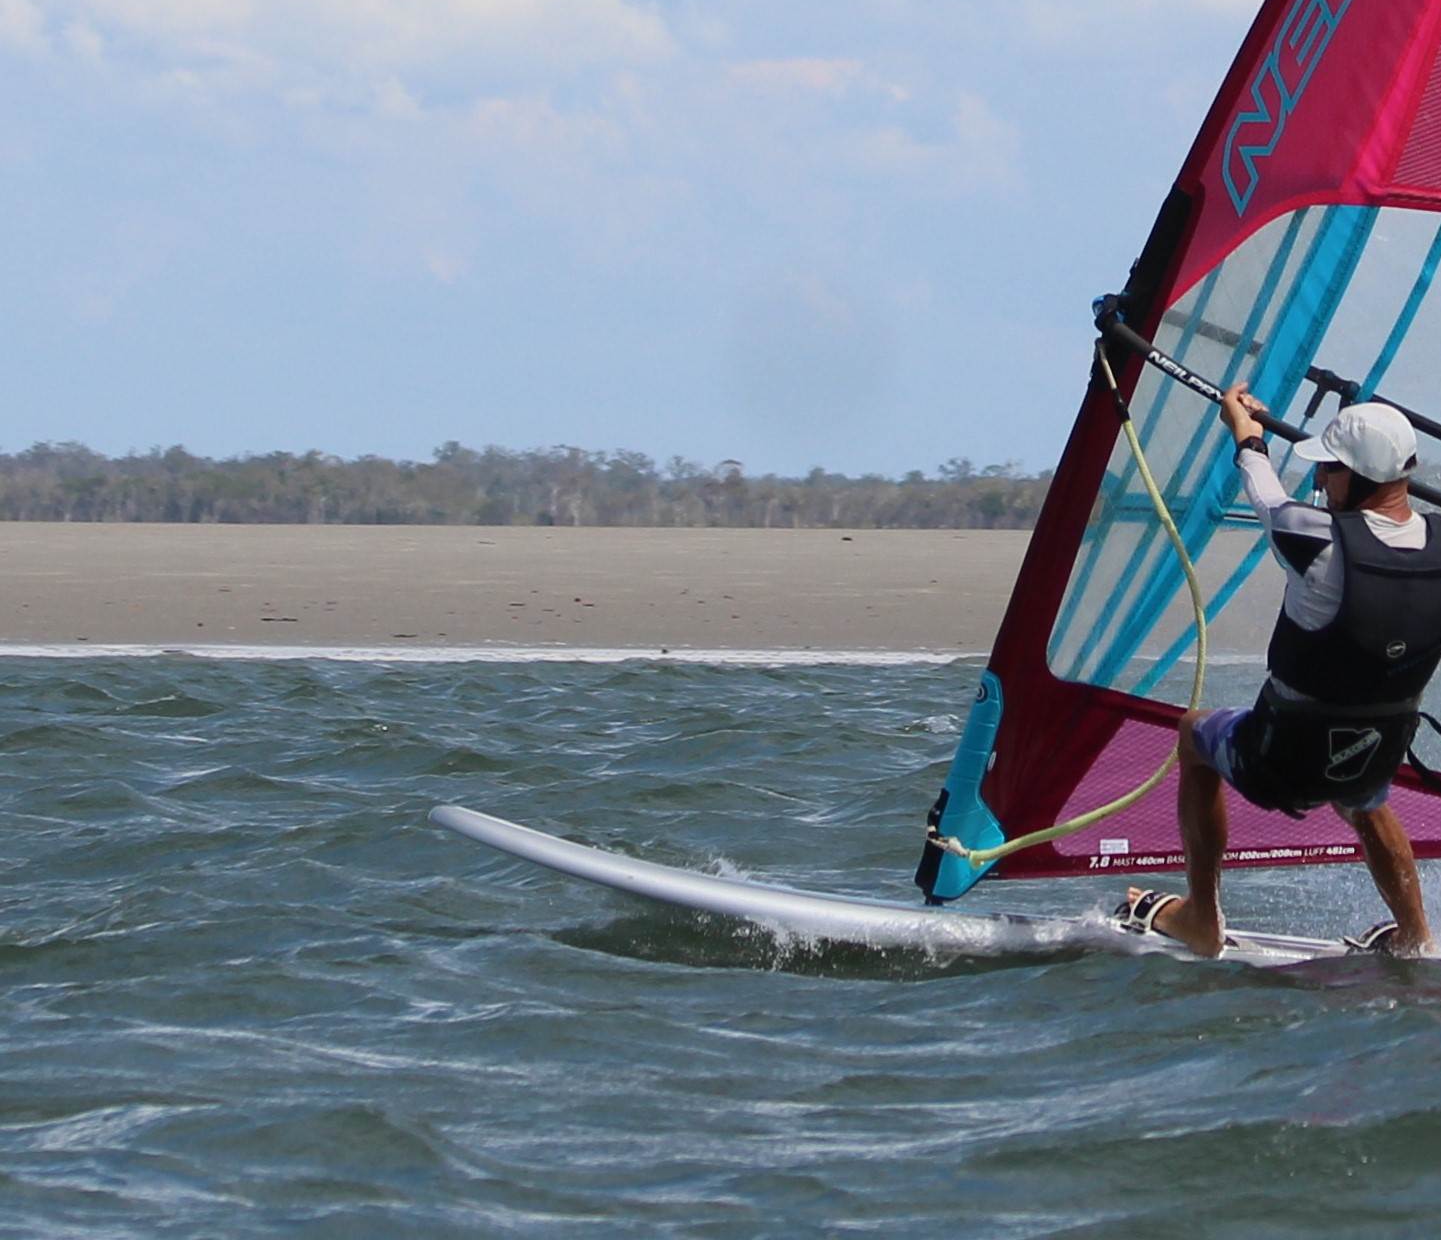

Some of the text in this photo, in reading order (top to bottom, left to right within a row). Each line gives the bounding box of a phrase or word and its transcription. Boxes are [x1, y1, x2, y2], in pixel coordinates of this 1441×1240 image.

[1148, 350, 1225, 401] NEILPRY
[1112, 857, 1134, 867] MAST
[1304, 847, 1325, 857] LUFF
